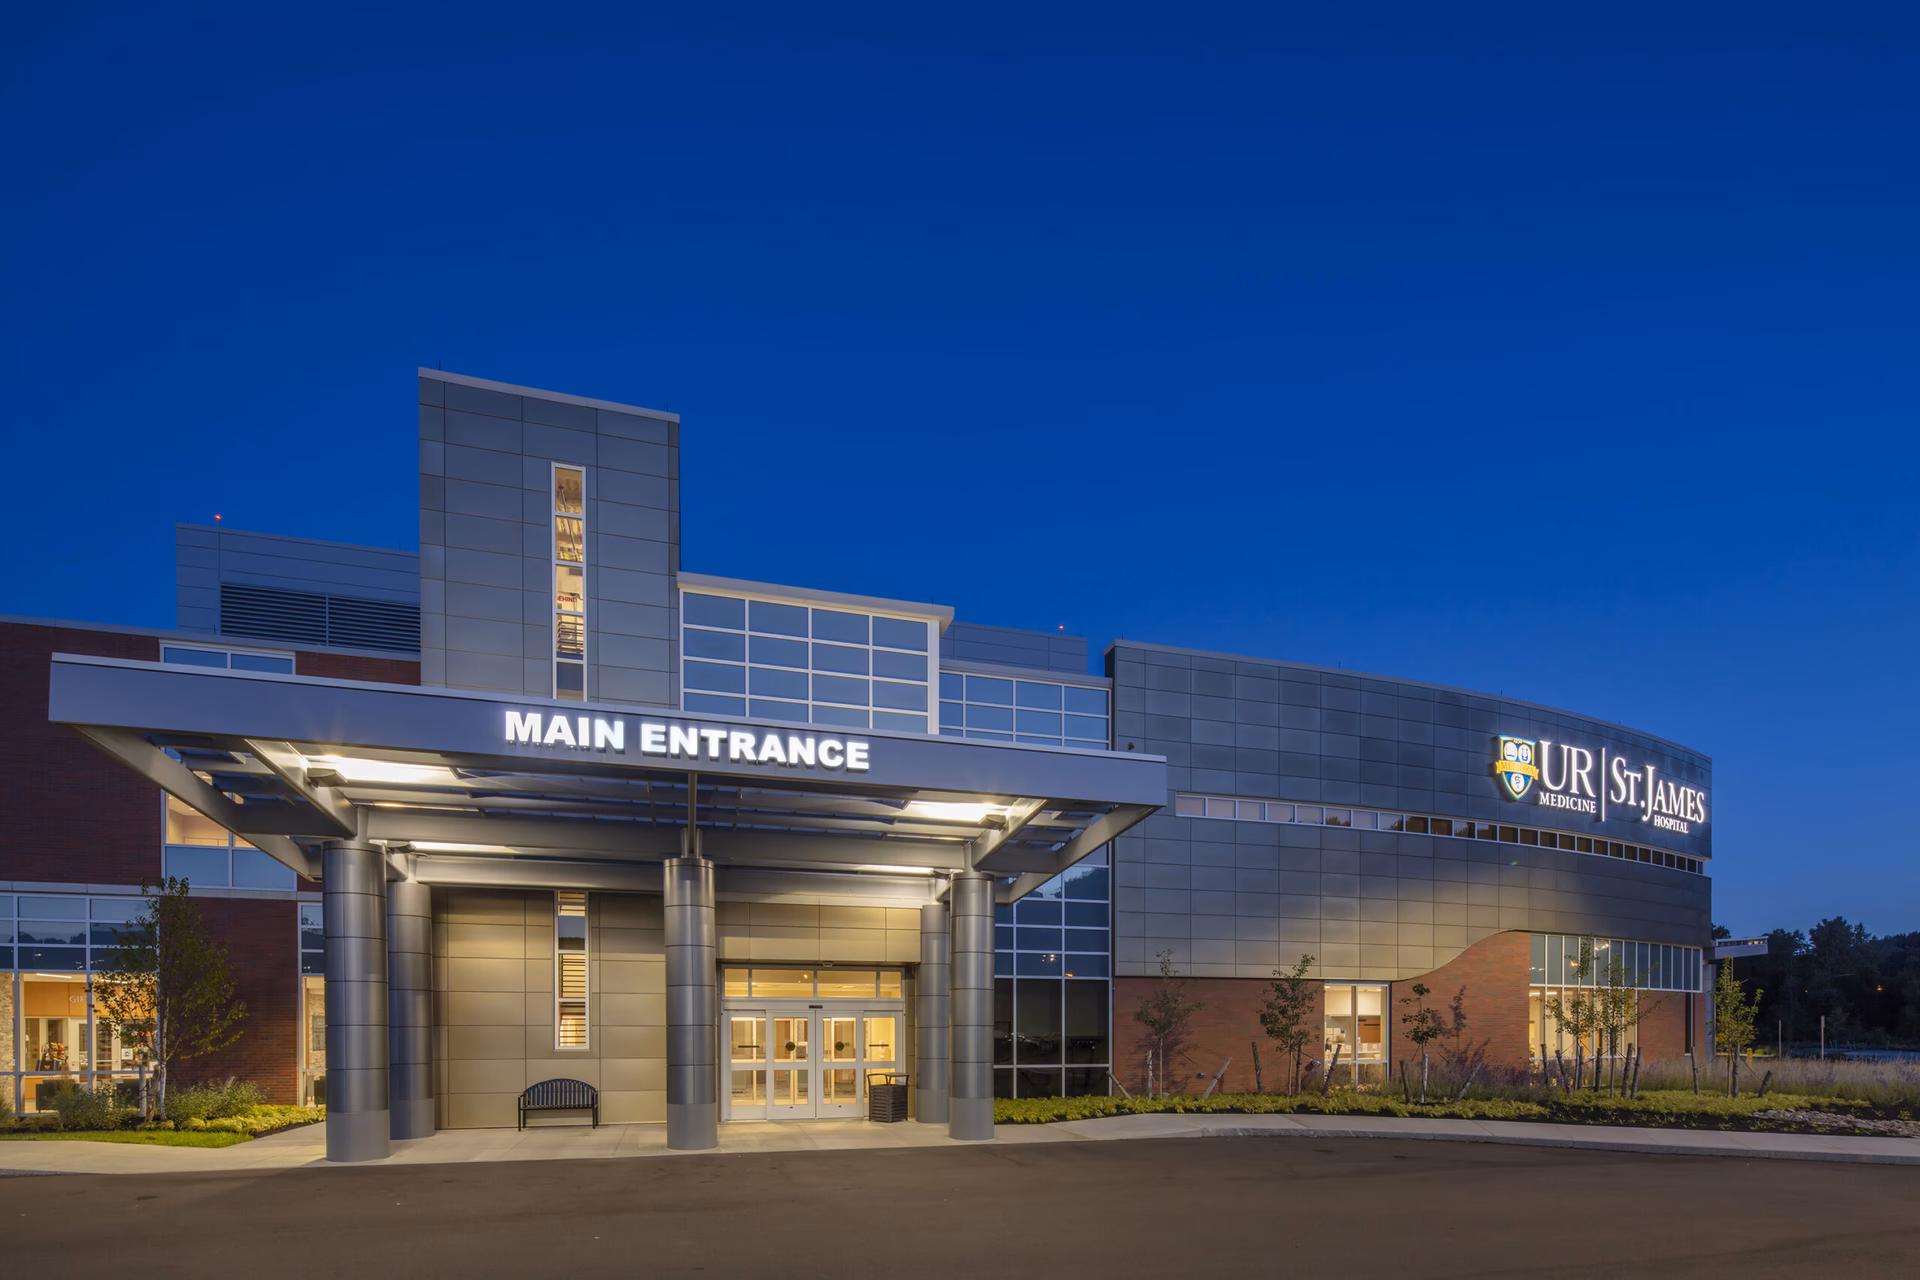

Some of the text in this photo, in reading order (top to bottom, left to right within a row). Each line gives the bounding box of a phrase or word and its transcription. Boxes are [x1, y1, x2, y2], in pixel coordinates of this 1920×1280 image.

[505, 710, 870, 771] MAIN ENTRANCE
[1540, 740, 1596, 798] UR
[1539, 792, 1597, 813] MEDICINE
[1642, 765, 1705, 823] JAMES
[1654, 814, 1689, 834] HOSPITAL
[69, 995, 87, 1003] GIF
